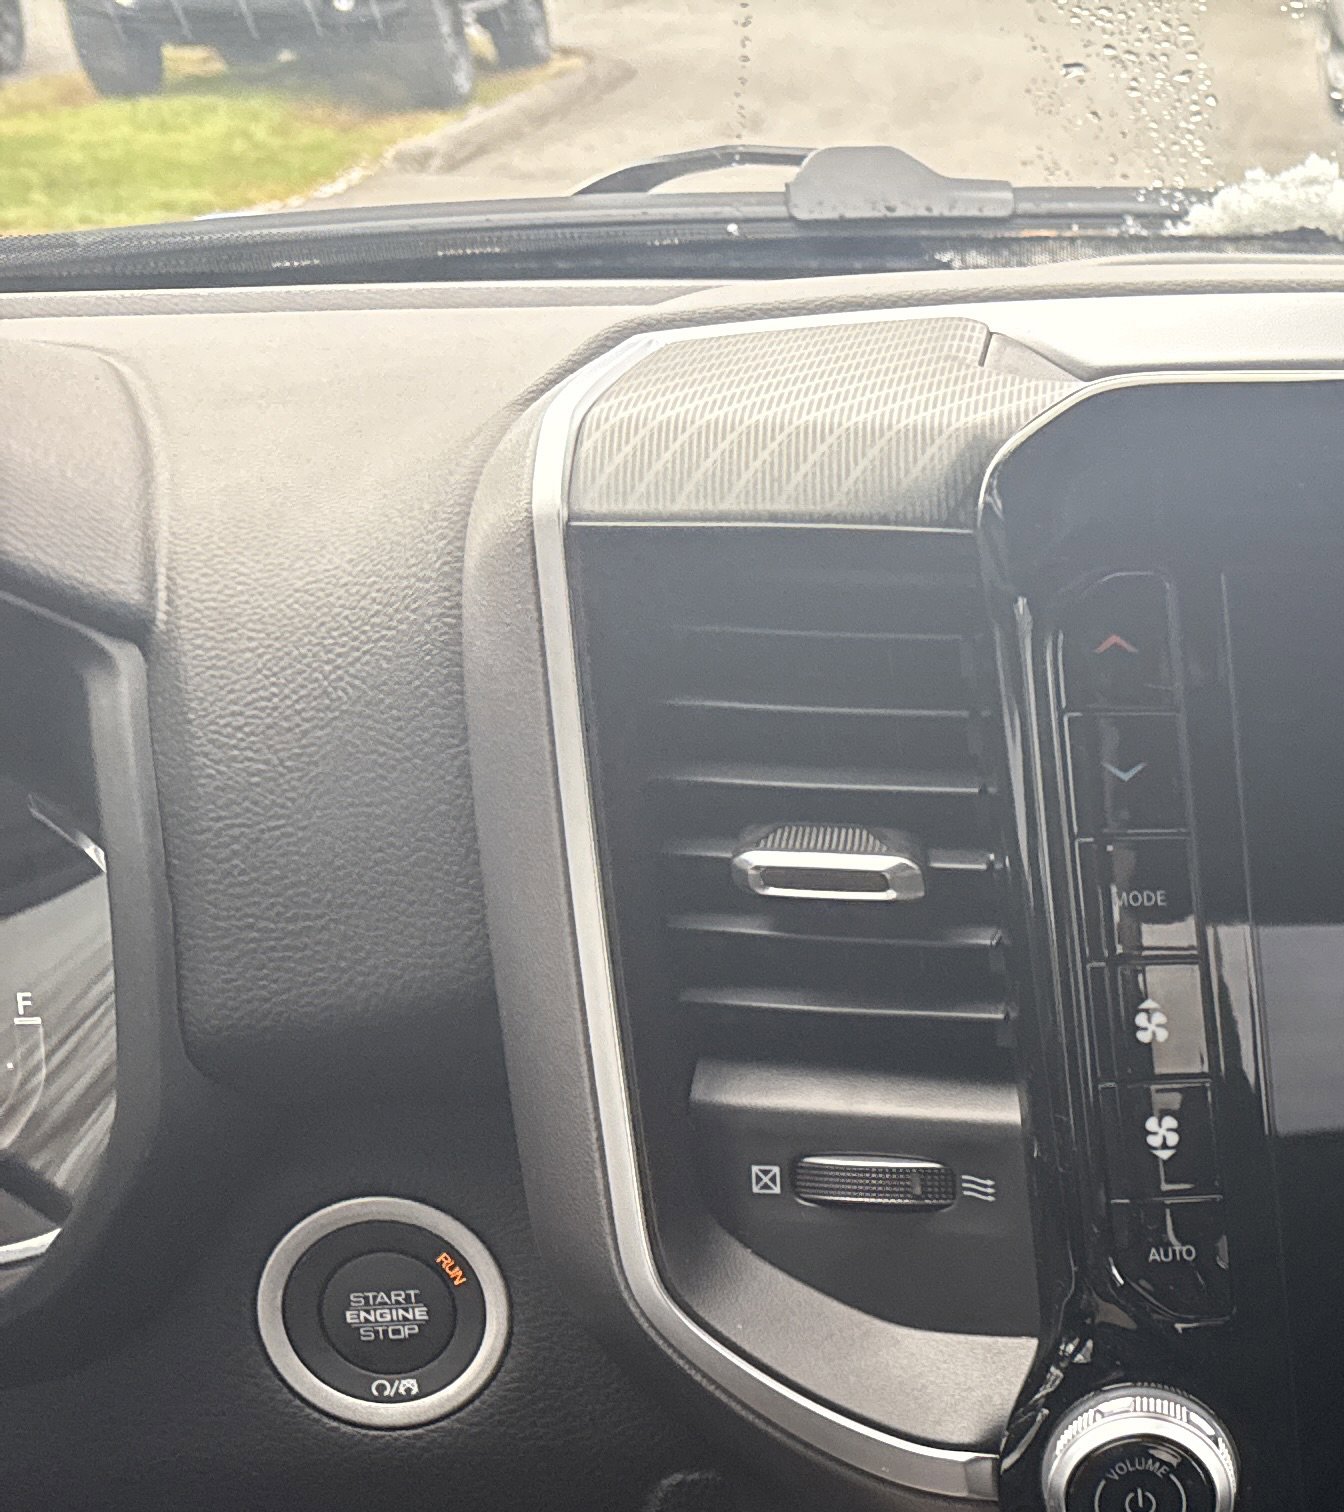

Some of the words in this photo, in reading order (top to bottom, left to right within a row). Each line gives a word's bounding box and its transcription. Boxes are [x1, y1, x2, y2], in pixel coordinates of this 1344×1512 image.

[1115, 890, 1168, 907] MODE
[16, 991, 33, 1015] F
[1148, 1246, 1196, 1262] AUTO
[435, 1252, 466, 1286] RUN
[350, 1290, 420, 1306] START
[345, 1307, 429, 1324] ENGINE
[360, 1325, 419, 1341] STOP
[1106, 1457, 1170, 1480] VOLUME
